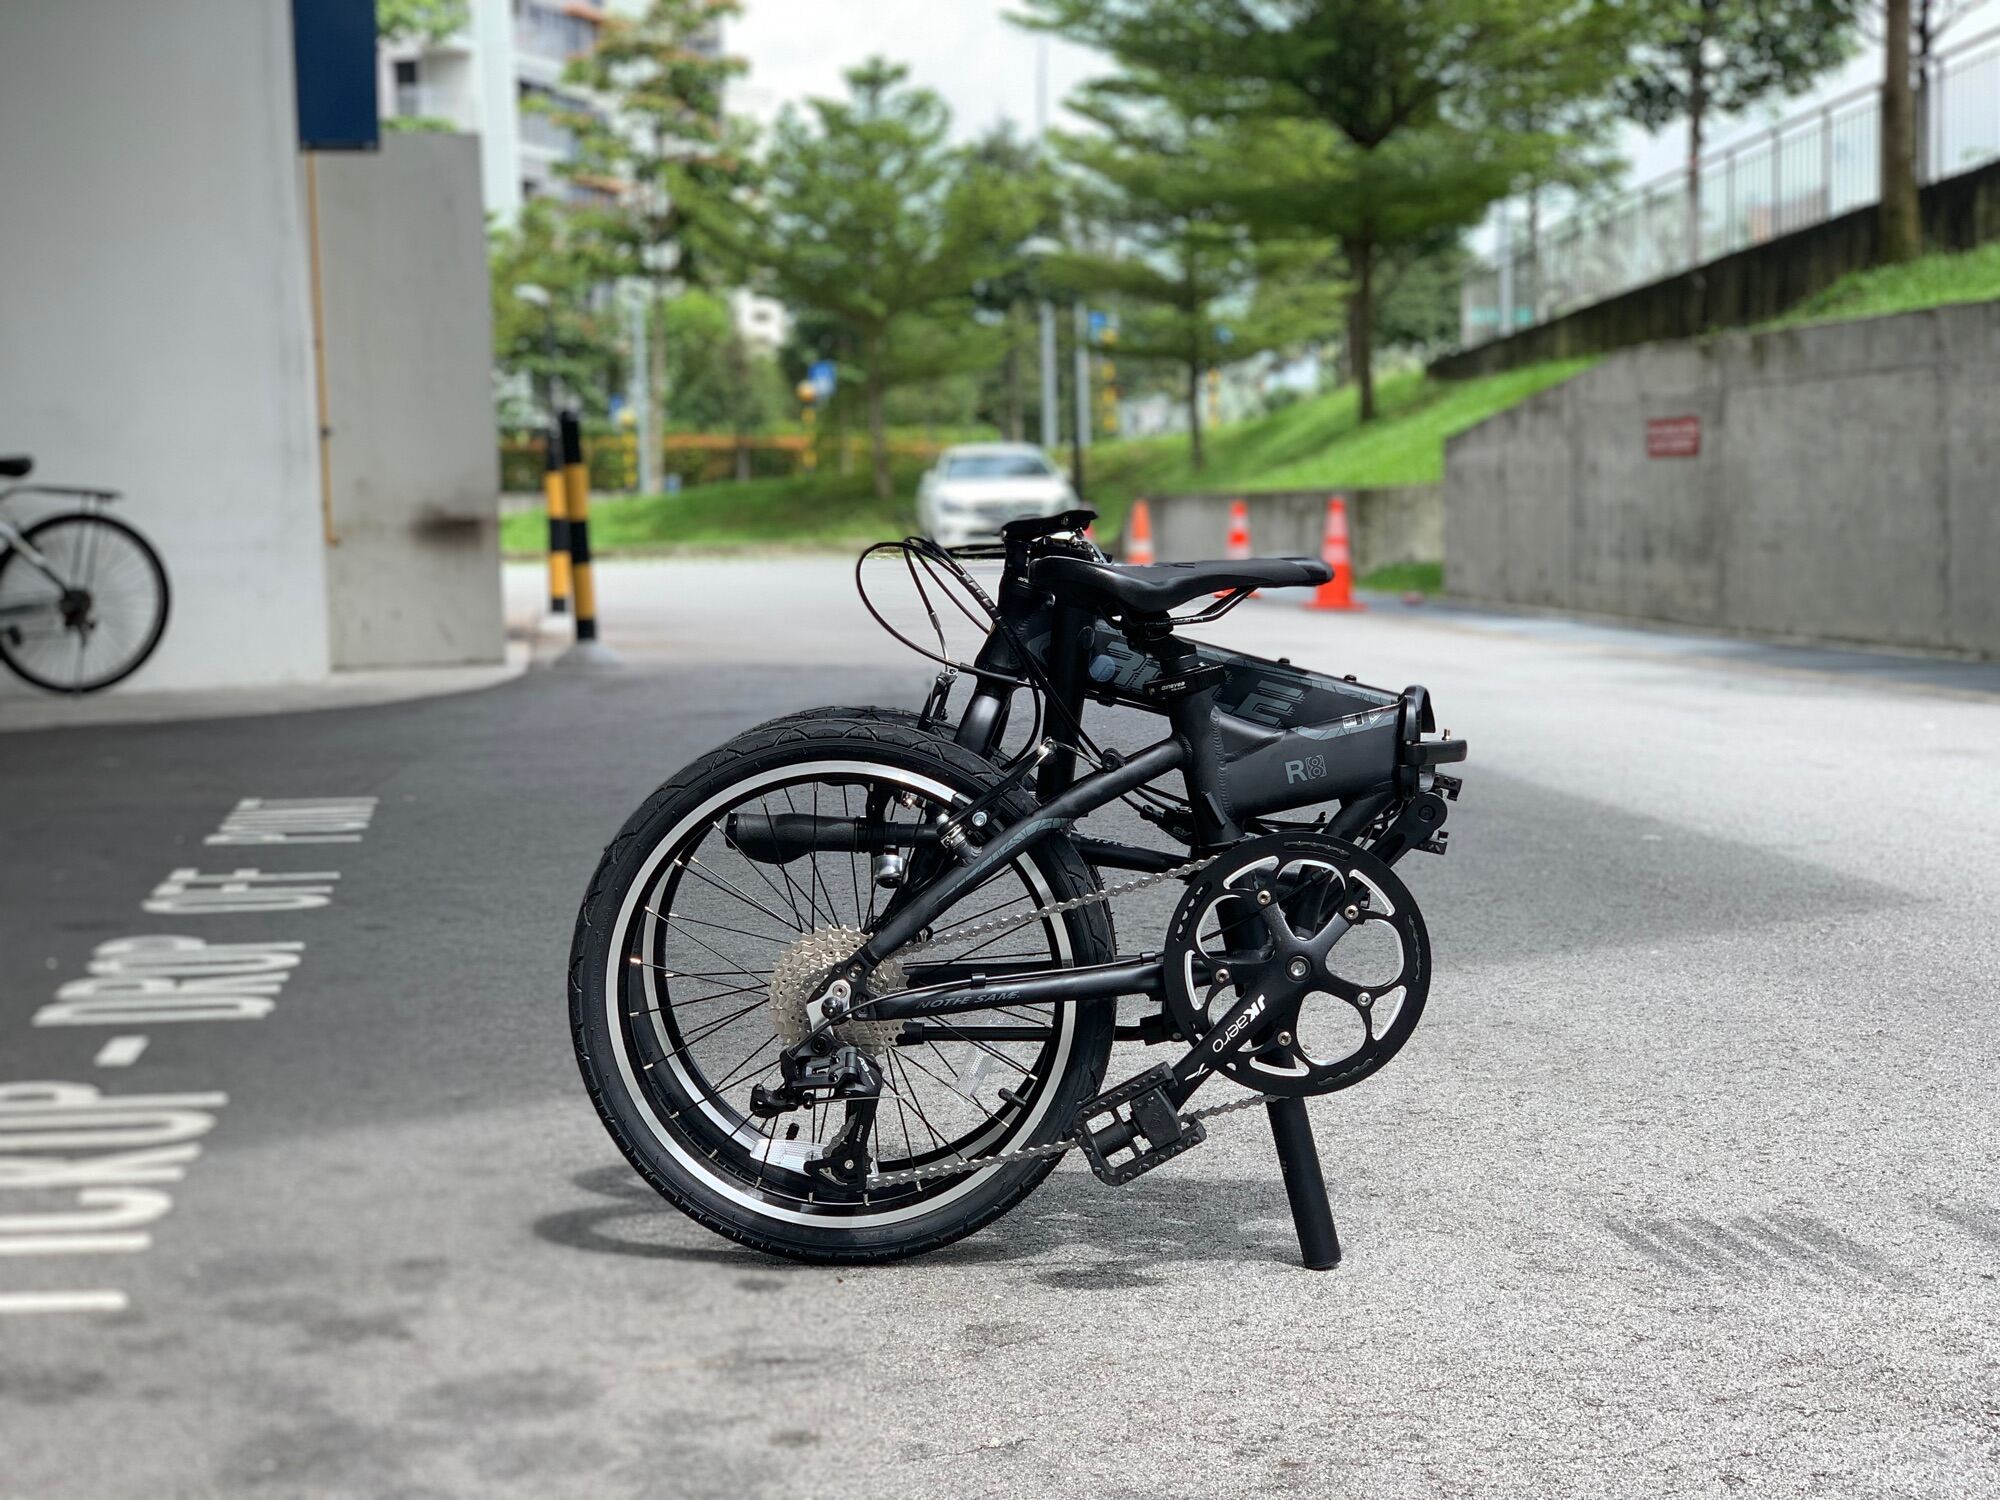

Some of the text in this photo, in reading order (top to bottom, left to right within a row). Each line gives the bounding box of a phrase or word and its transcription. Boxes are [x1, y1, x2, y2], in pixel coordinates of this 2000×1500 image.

[1285, 755, 1327, 784] R8
[141, 868, 341, 914] OFF
[32, 934, 305, 1027] DROP
[1212, 994, 1266, 1053] JKaero
